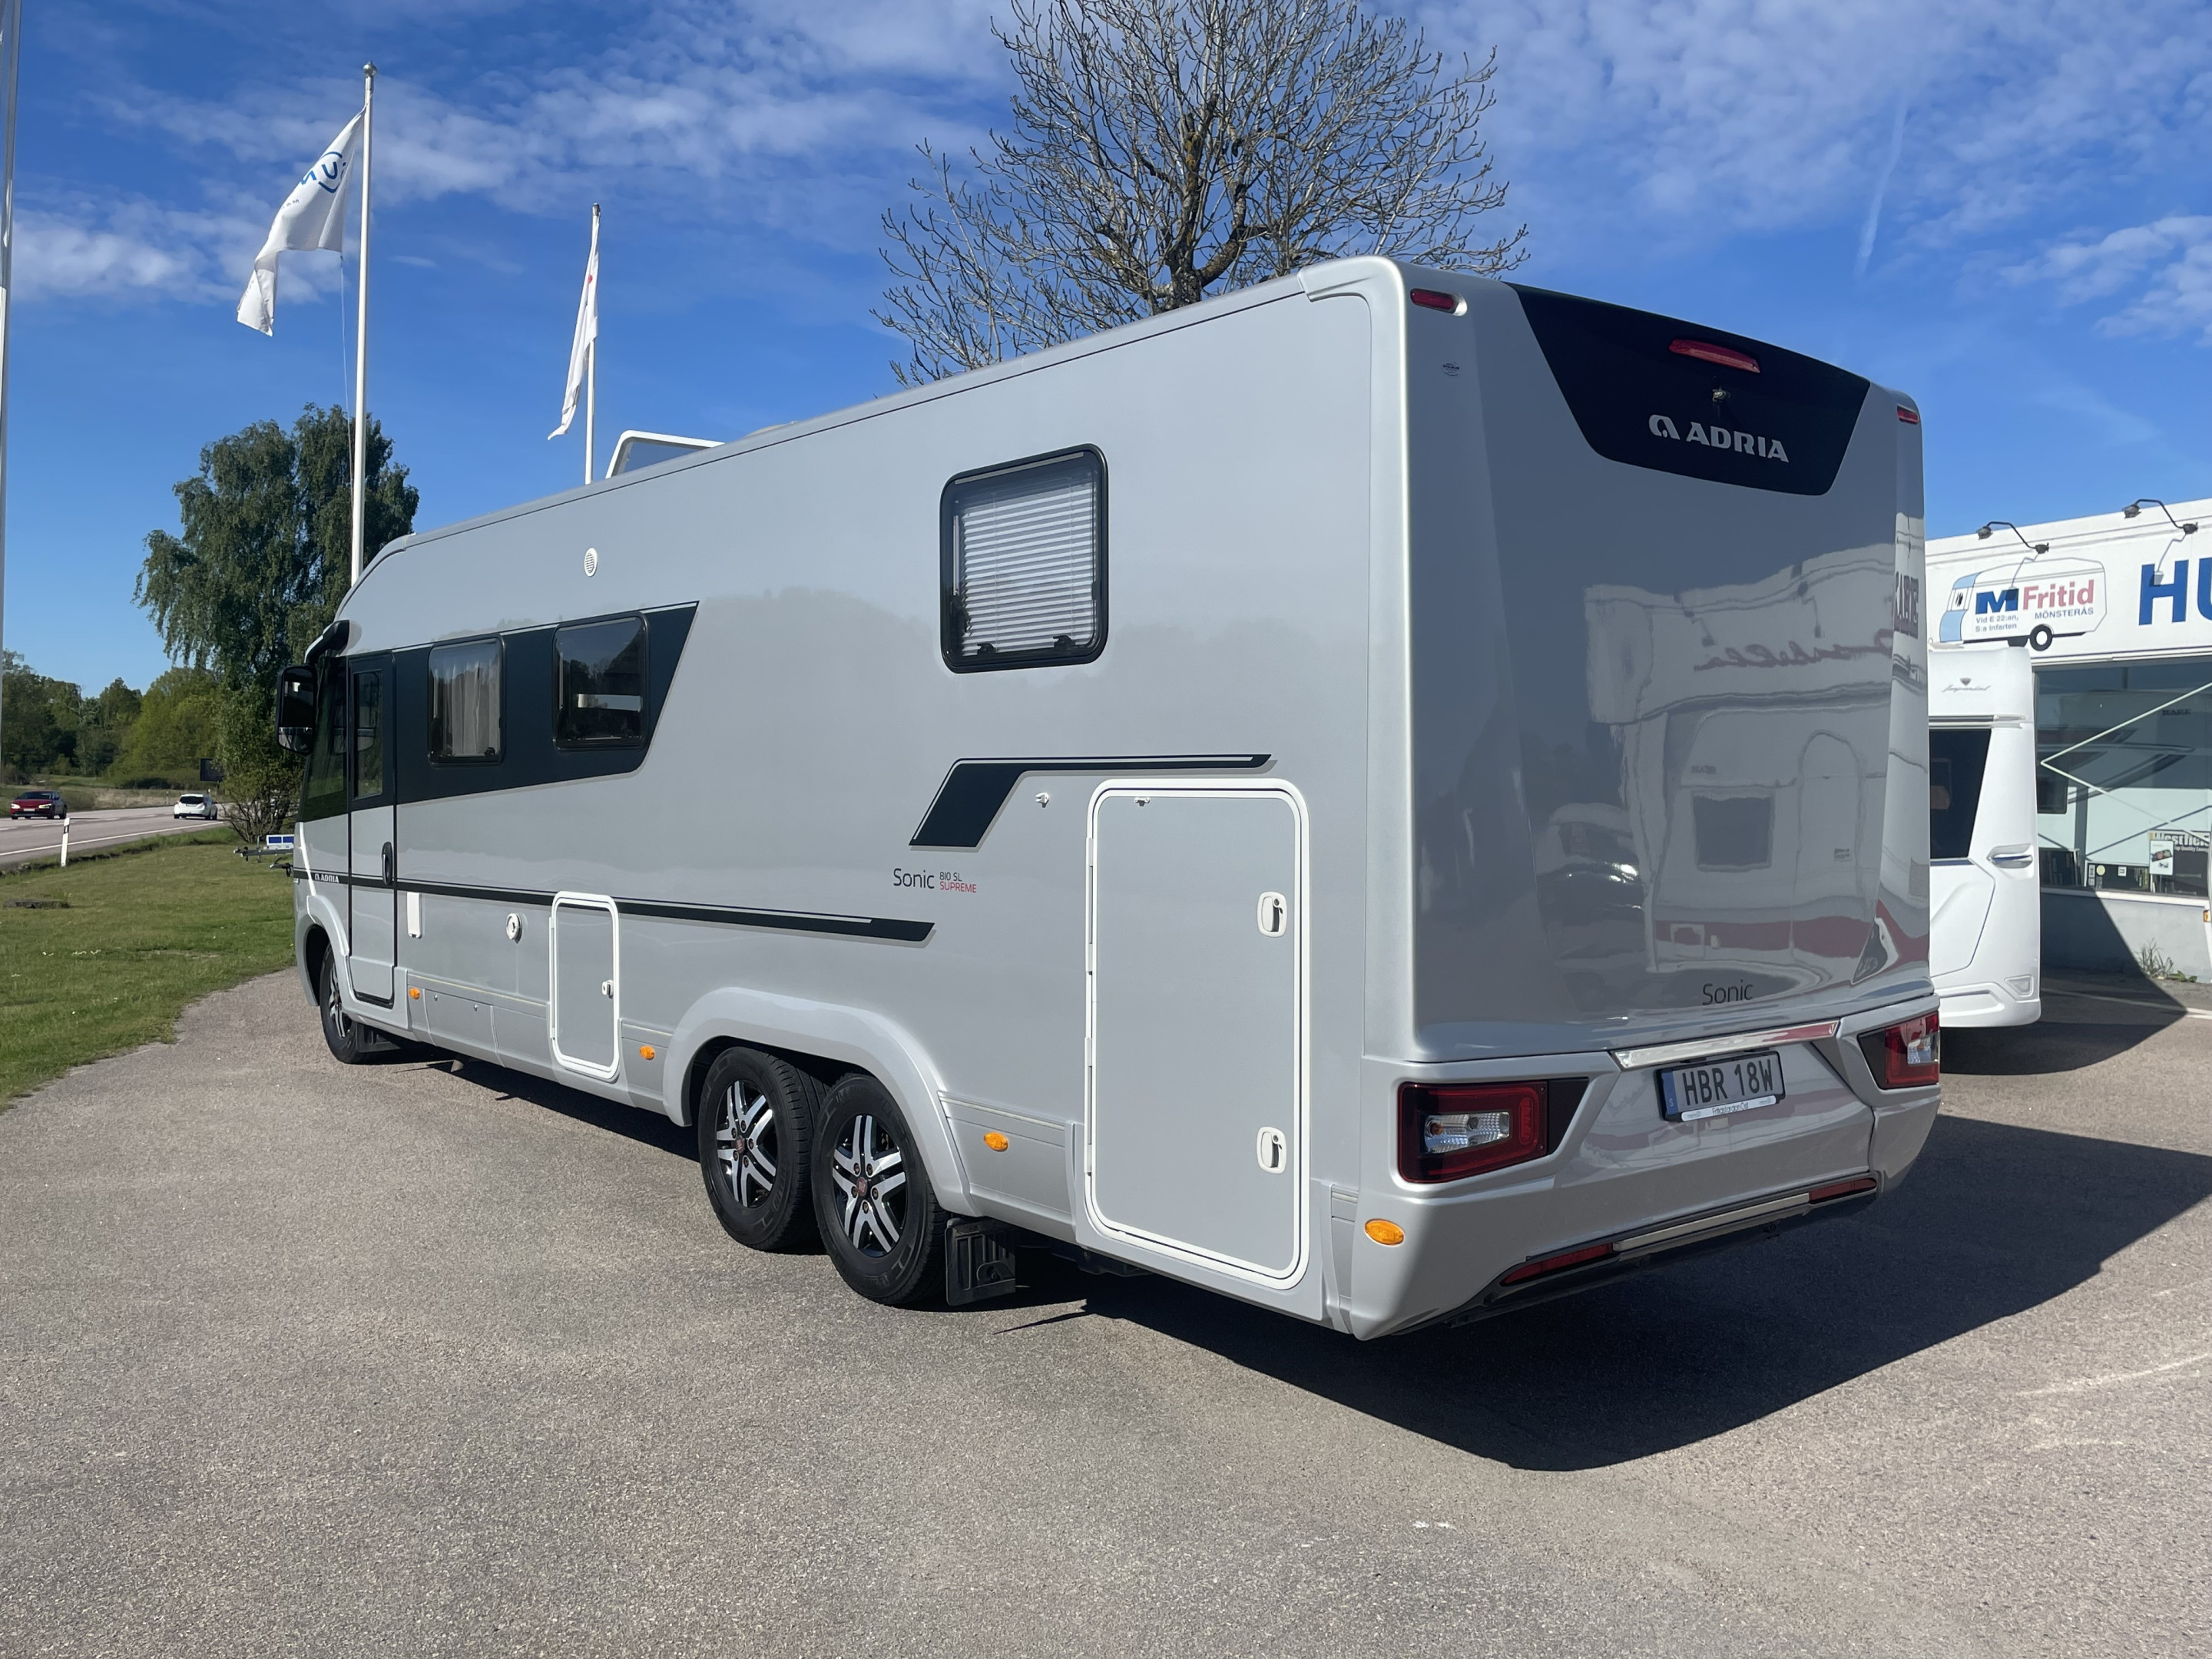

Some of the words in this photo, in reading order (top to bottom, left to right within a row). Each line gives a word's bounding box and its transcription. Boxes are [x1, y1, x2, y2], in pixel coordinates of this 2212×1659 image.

[1686, 421, 1790, 463] ADRIA
[2022, 579, 2094, 611] Fritid
[2035, 606, 2094, 620] MÖNSTERÅS
[320, 873, 339, 883] ADRIA
[893, 868, 935, 889] Sonic
[939, 872, 951, 881] 810
[953, 873, 962, 882] SL
[939, 881, 977, 893] SUPREME
[1702, 979, 1754, 1006] Sonic
[1682, 1067, 1728, 1106] HBR
[1734, 1058, 1774, 1096] 18W
[1669, 1098, 1675, 1108] S
